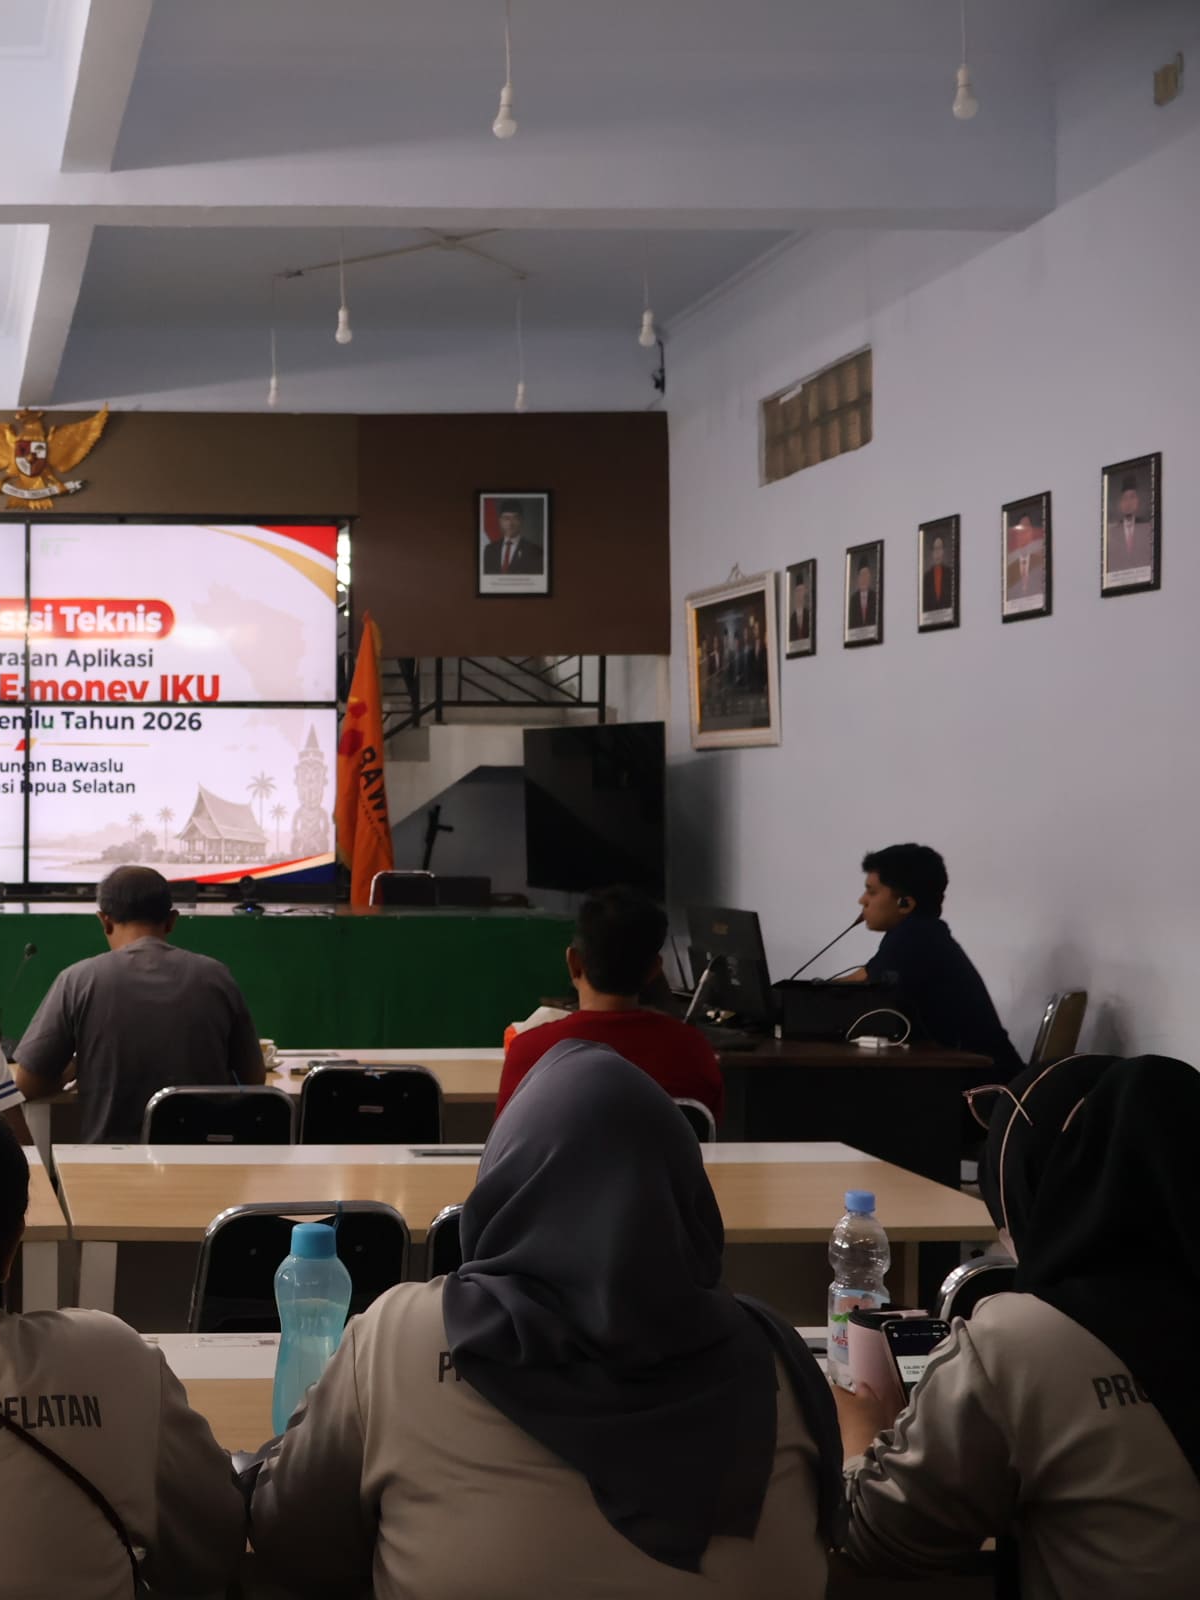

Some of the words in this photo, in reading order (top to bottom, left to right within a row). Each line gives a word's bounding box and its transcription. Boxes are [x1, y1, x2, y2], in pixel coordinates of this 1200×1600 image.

[59, 603, 163, 633] Teknis
[65, 648, 154, 673] Aplikasi
[160, 674, 220, 702] IKU
[60, 710, 135, 731] Tahun
[142, 711, 202, 731] 2026
[51, 758, 124, 774] Bawaslu
[72, 780, 136, 794] Selatan
